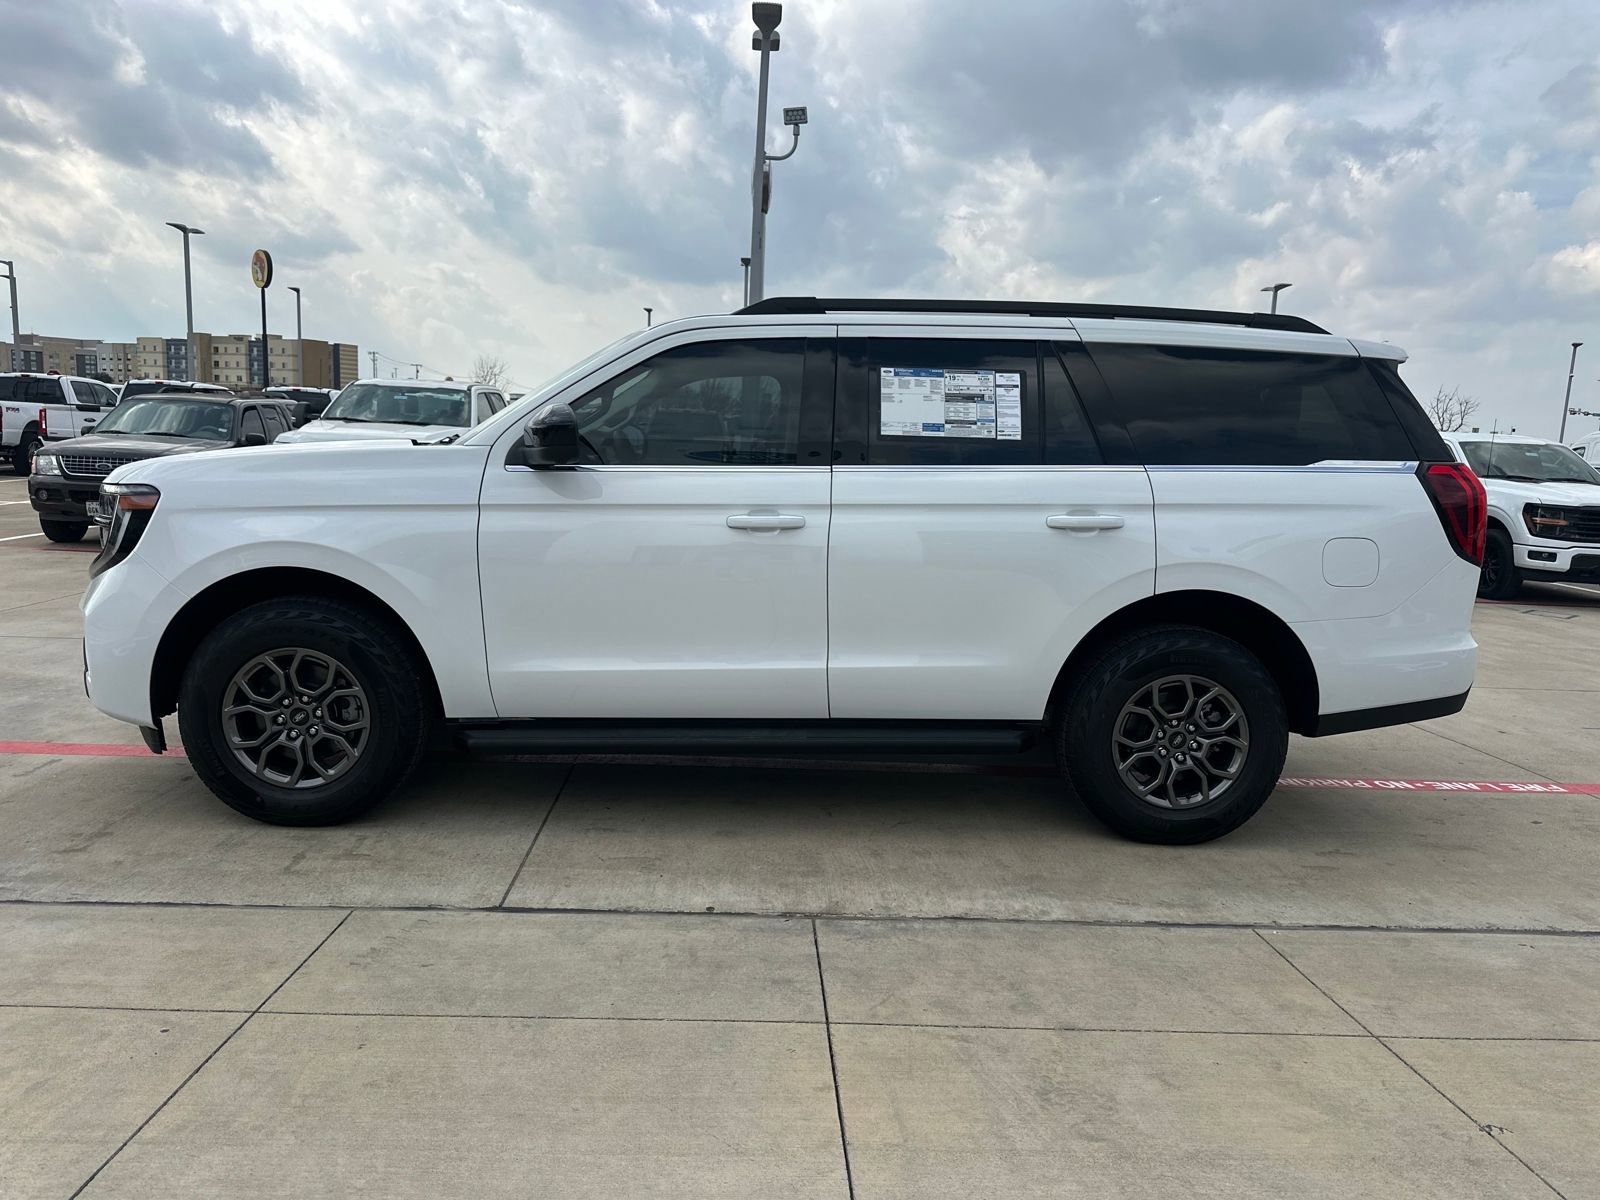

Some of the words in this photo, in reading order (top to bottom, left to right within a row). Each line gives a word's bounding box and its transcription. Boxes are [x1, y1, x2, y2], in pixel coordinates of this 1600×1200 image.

[1276, 778, 1373, 788] PARKIN
[1373, 780, 1416, 789] NO
[1424, 781, 1503, 791] LANE
[1499, 783, 1569, 792] FIRE
